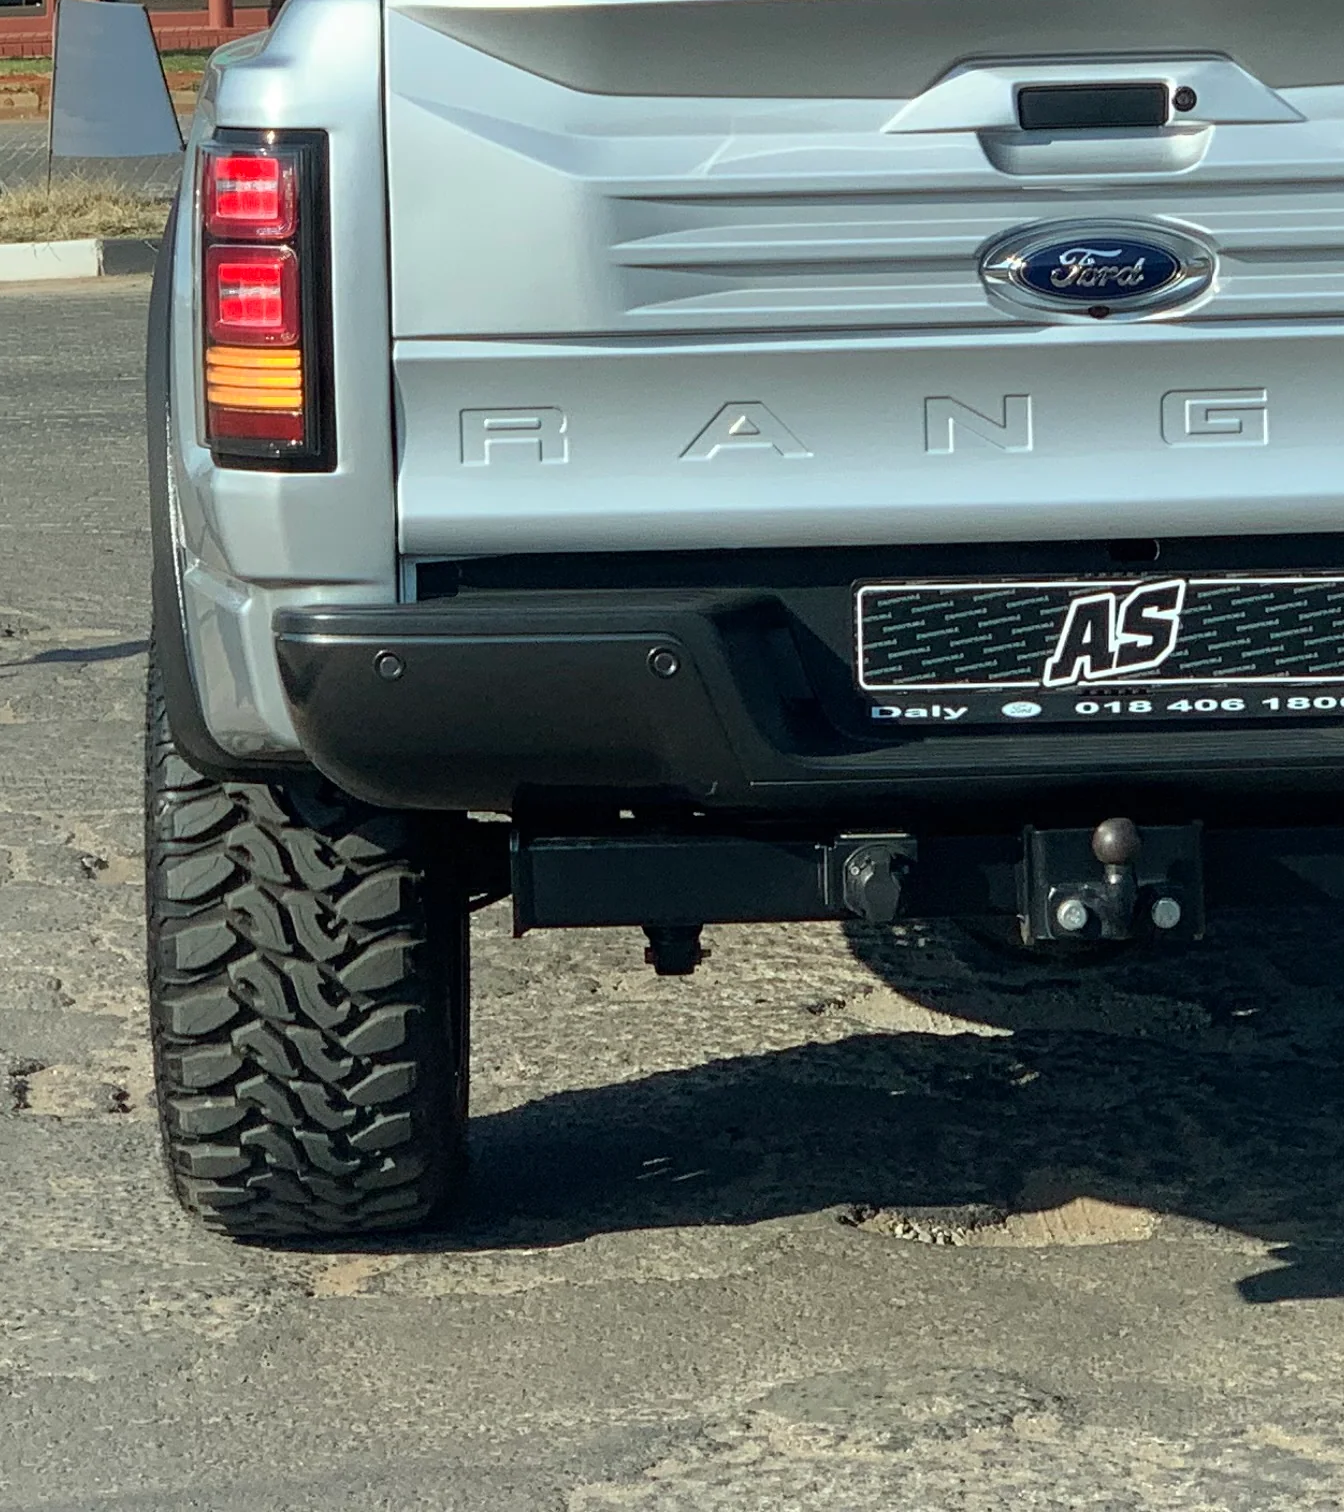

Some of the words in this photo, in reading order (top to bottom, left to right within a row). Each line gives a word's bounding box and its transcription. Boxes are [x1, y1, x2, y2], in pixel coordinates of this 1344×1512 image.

[1051, 247, 1145, 288] Ford
[1043, 579, 1186, 687] AS
[871, 705, 968, 720] Daly
[1075, 700, 1152, 714] 018
[1166, 698, 1246, 712] 406
